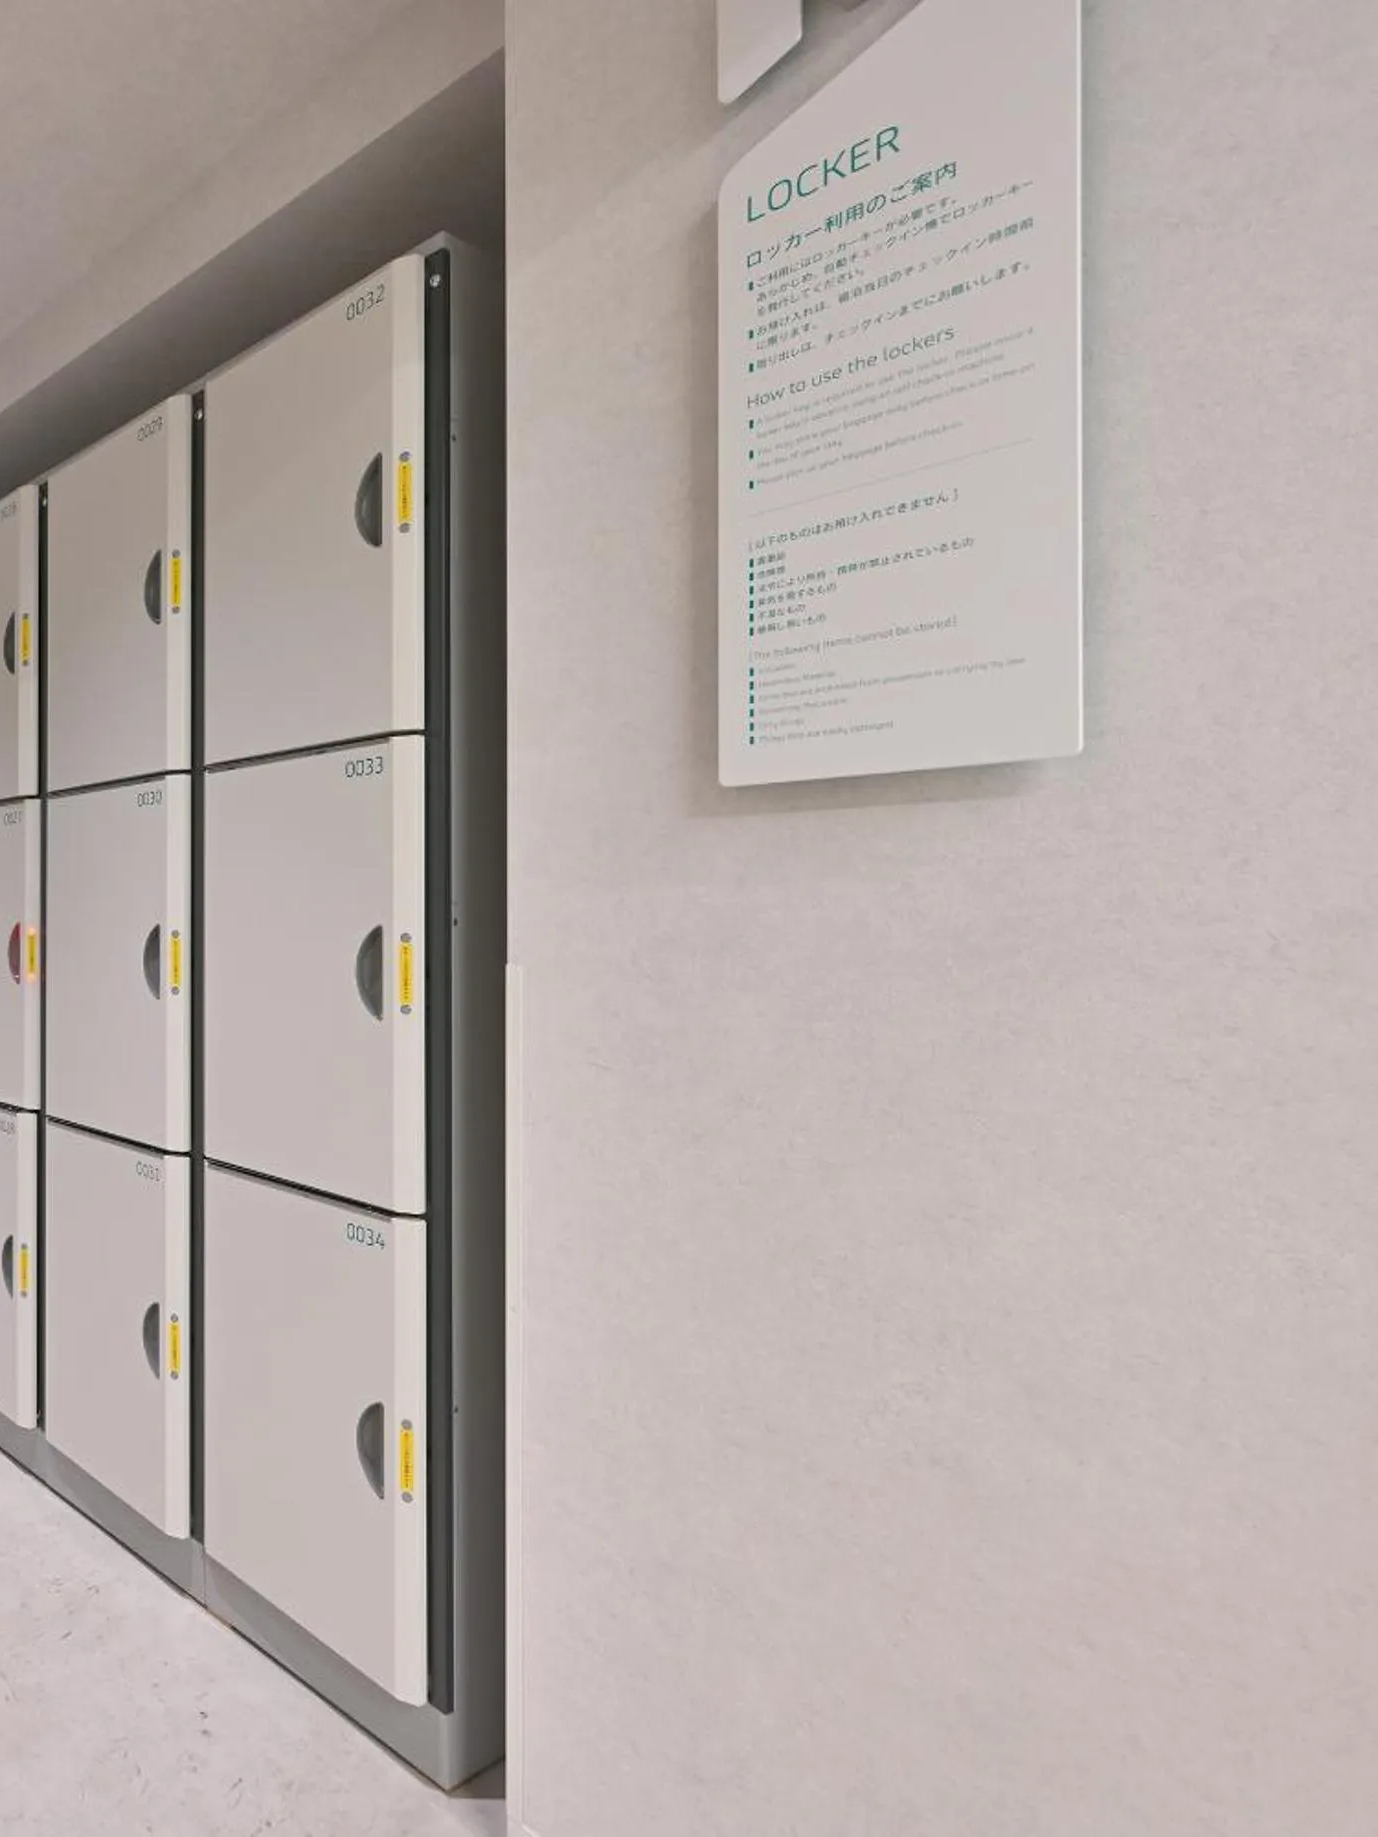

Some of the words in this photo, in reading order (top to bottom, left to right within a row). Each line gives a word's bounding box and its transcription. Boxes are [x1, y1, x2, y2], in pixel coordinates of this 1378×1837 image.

[746, 126, 901, 223] LOCKER
[746, 161, 957, 268] ロッカー利用のご案内
[346, 283, 385, 321] 0032
[747, 386, 786, 409] How
[789, 380, 806, 395] to
[811, 367, 843, 387] use
[848, 355, 878, 374] the
[882, 326, 955, 362] lockers
[345, 756, 383, 778] 0033
[347, 1223, 385, 1250] 0034
